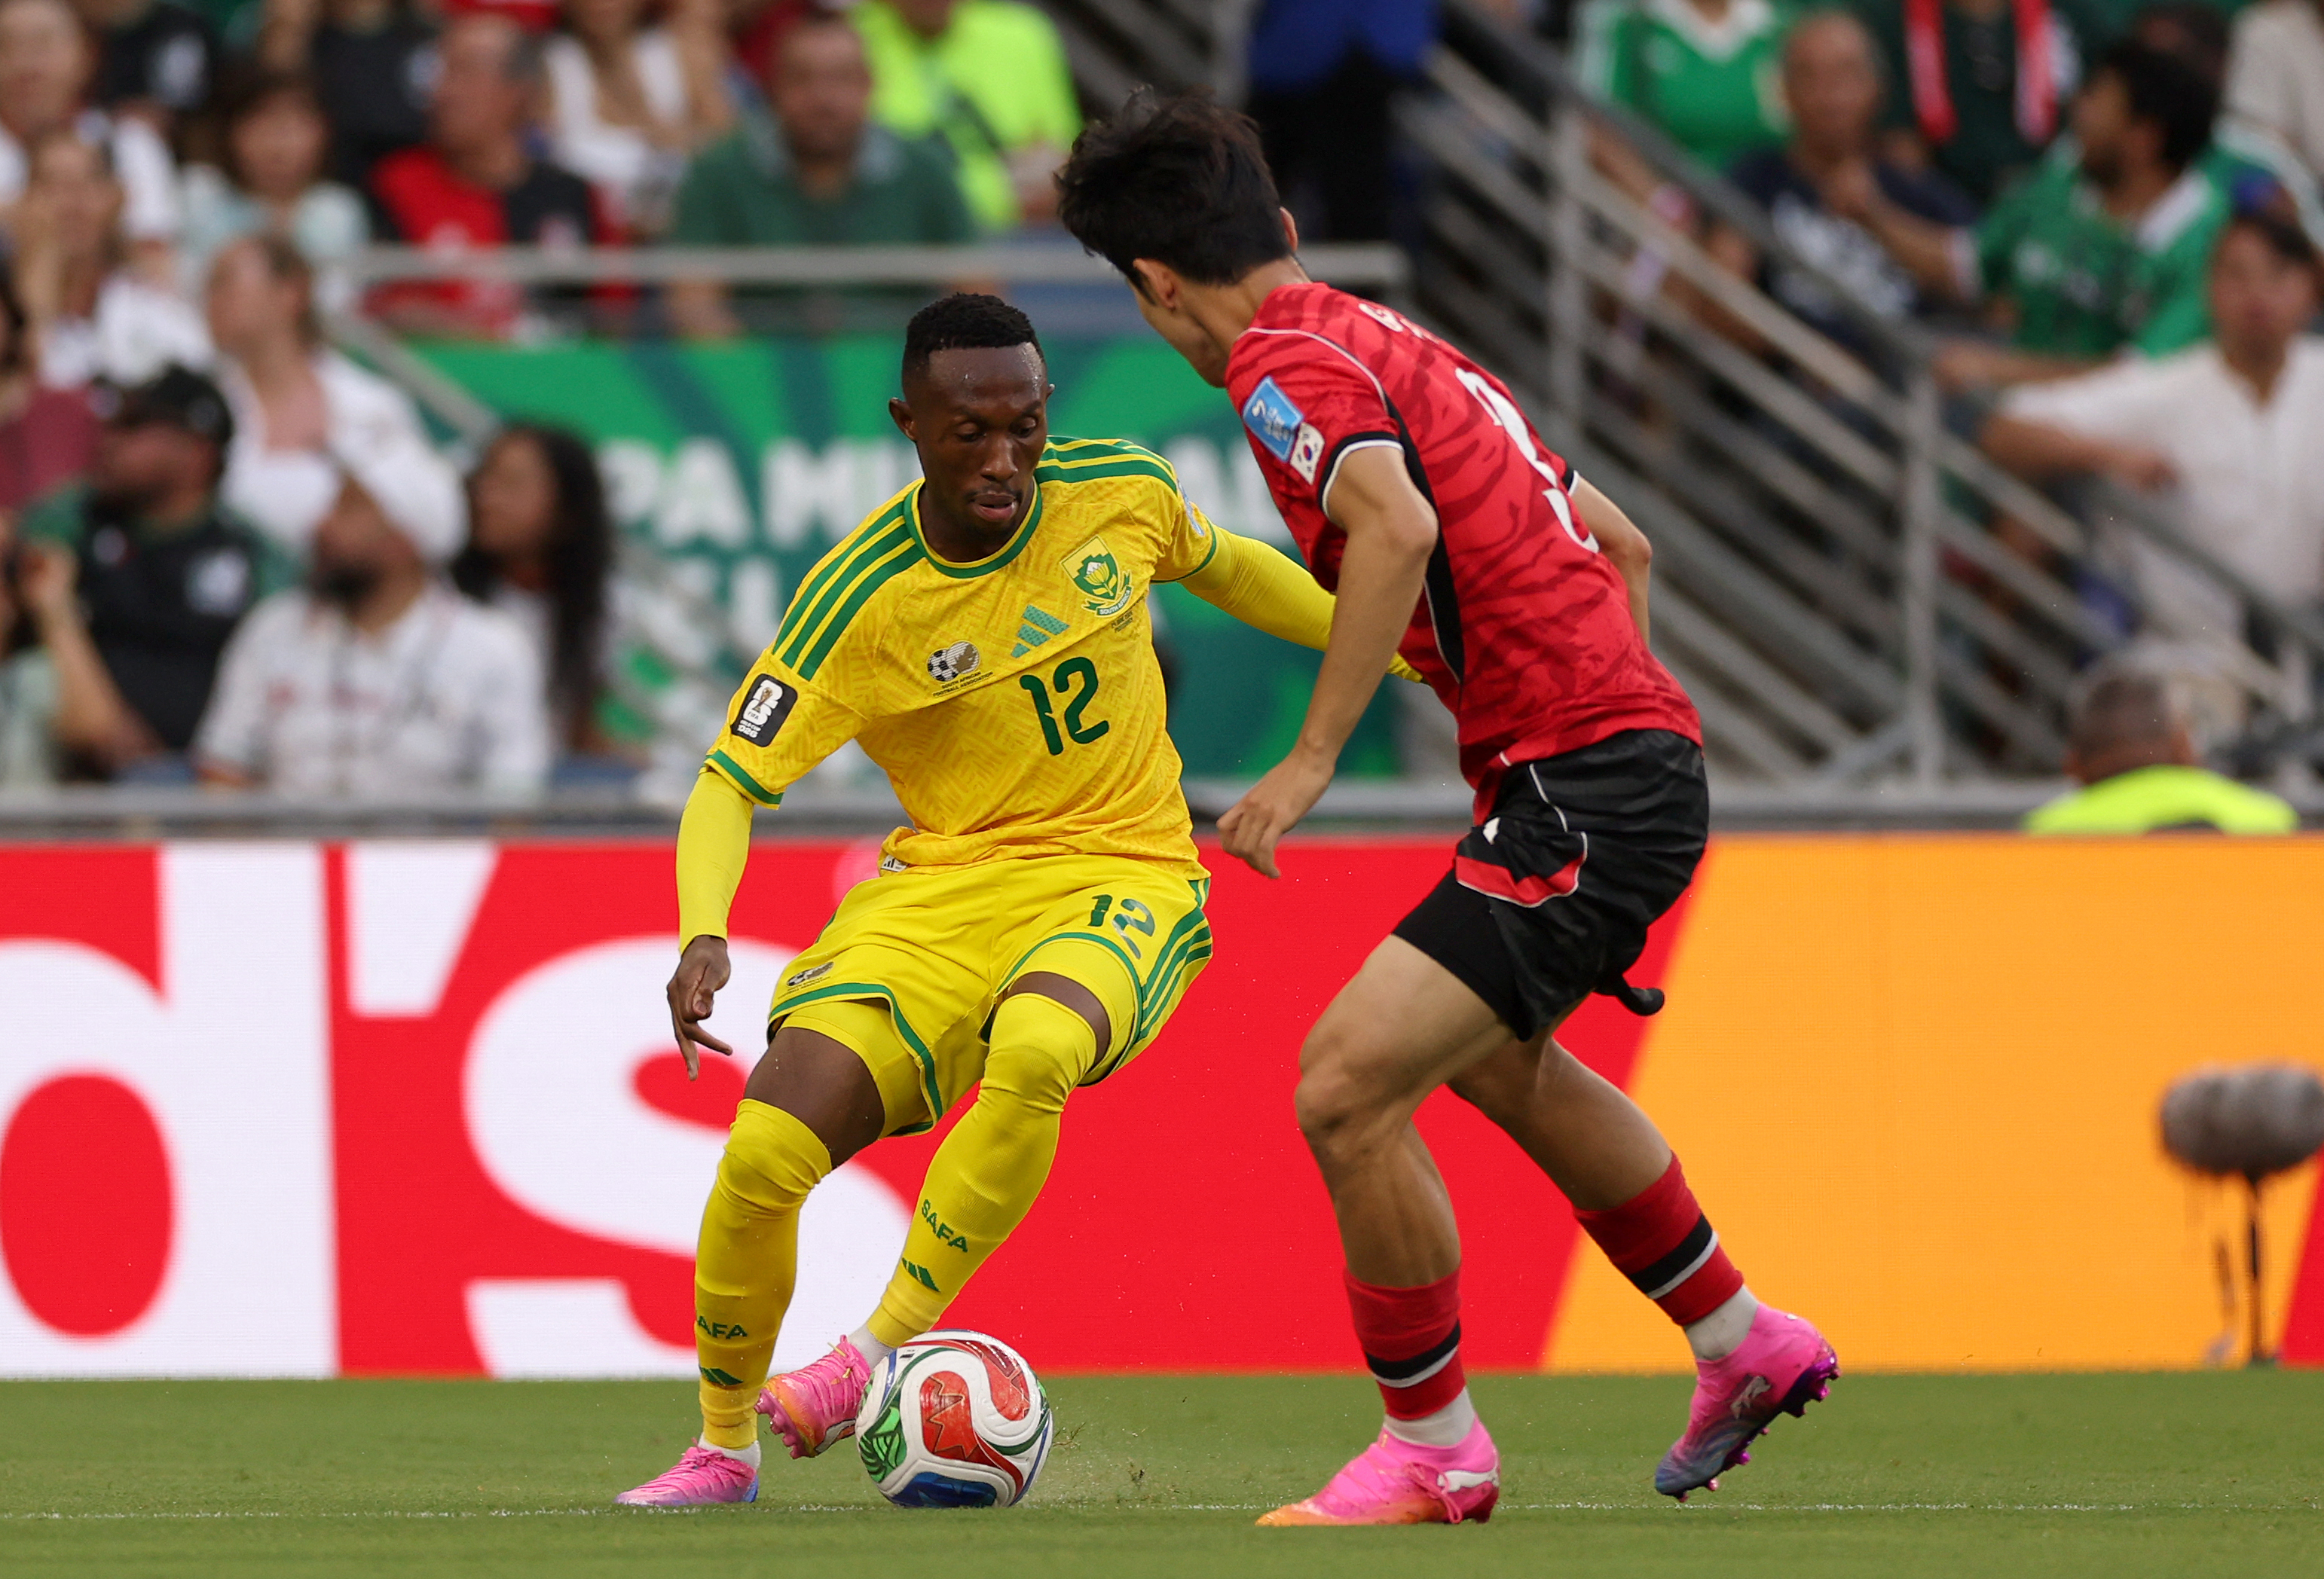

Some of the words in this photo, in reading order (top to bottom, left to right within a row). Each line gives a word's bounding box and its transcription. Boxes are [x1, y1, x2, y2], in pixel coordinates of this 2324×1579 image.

[1099, 605, 1119, 615] SOUTH
[933, 686, 959, 697] FOOTBALL
[941, 680, 959, 689] SOUTH
[1020, 656, 1110, 756] 12
[1087, 893, 1156, 961] 12
[922, 1199, 968, 1253] SAFA
[698, 1315, 748, 1339] AFA
